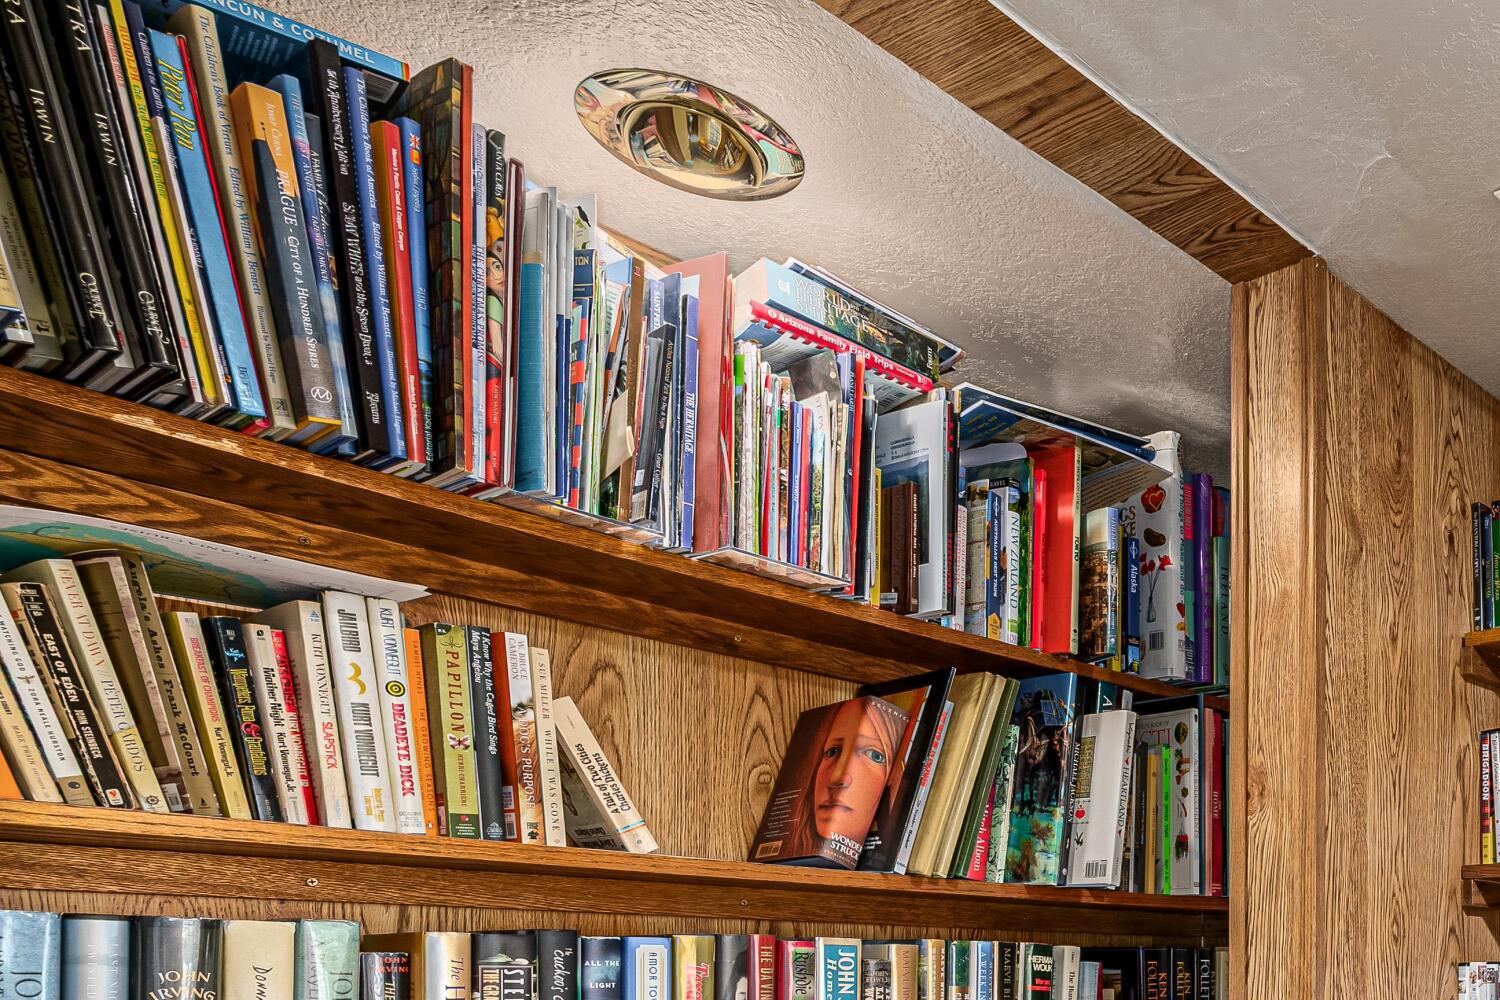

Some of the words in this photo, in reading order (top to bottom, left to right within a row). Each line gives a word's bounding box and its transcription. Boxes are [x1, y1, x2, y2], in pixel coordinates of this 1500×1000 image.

[199, 15, 210, 34] The
[203, 35, 223, 82] Children's
[156, 59, 185, 111] Peter
[213, 84, 226, 110] Book
[29, 88, 55, 143] IRWIN
[169, 111, 197, 151] Pan
[218, 111, 226, 120] of
[94, 112, 118, 167] IRWIN
[220, 122, 233, 156] Virtues
[276, 167, 298, 225] PRAGUE
[794, 275, 850, 312] WORLD
[778, 312, 815, 335] Arizona
[817, 329, 847, 350] Family
[850, 343, 870, 359] Field
[872, 355, 894, 370] Trips
[1011, 516, 1019, 542] NEW
[1009, 544, 1019, 609] ZEALAND
[127, 560, 150, 624] Angela's
[146, 627, 165, 669] Ashes
[337, 608, 362, 653] JAILBIRD
[42, 634, 60, 658] EAST
[190, 637, 208, 675] BREAKFAST
[53, 659, 65, 674] OF
[200, 677, 210, 687] OF
[538, 662, 547, 681] SUE
[58, 674, 79, 702] EDEN
[445, 649, 466, 733] PAPILLON
[539, 684, 551, 720] MILLER
[202, 688, 220, 723] CHAMPIONS
[163, 679, 181, 719] Frank
[175, 722, 200, 777] McCourt
[390, 702, 412, 751] DEADEYE
[321, 721, 337, 769] SLAPSTICK
[575, 743, 591, 765] Cities
[398, 751, 416, 797] DICK
[587, 765, 602, 783] Two
[593, 753, 614, 784] Dickens
[594, 784, 608, 794] of
[603, 791, 617, 808] Tale
[610, 783, 631, 811] Charles
[158, 970, 211, 983] JOHN
[450, 957, 465, 981] The
[584, 959, 601, 967] ALL
[605, 959, 620, 967] THE
[649, 952, 657, 973] AMOR
[837, 949, 855, 987] JOHN
